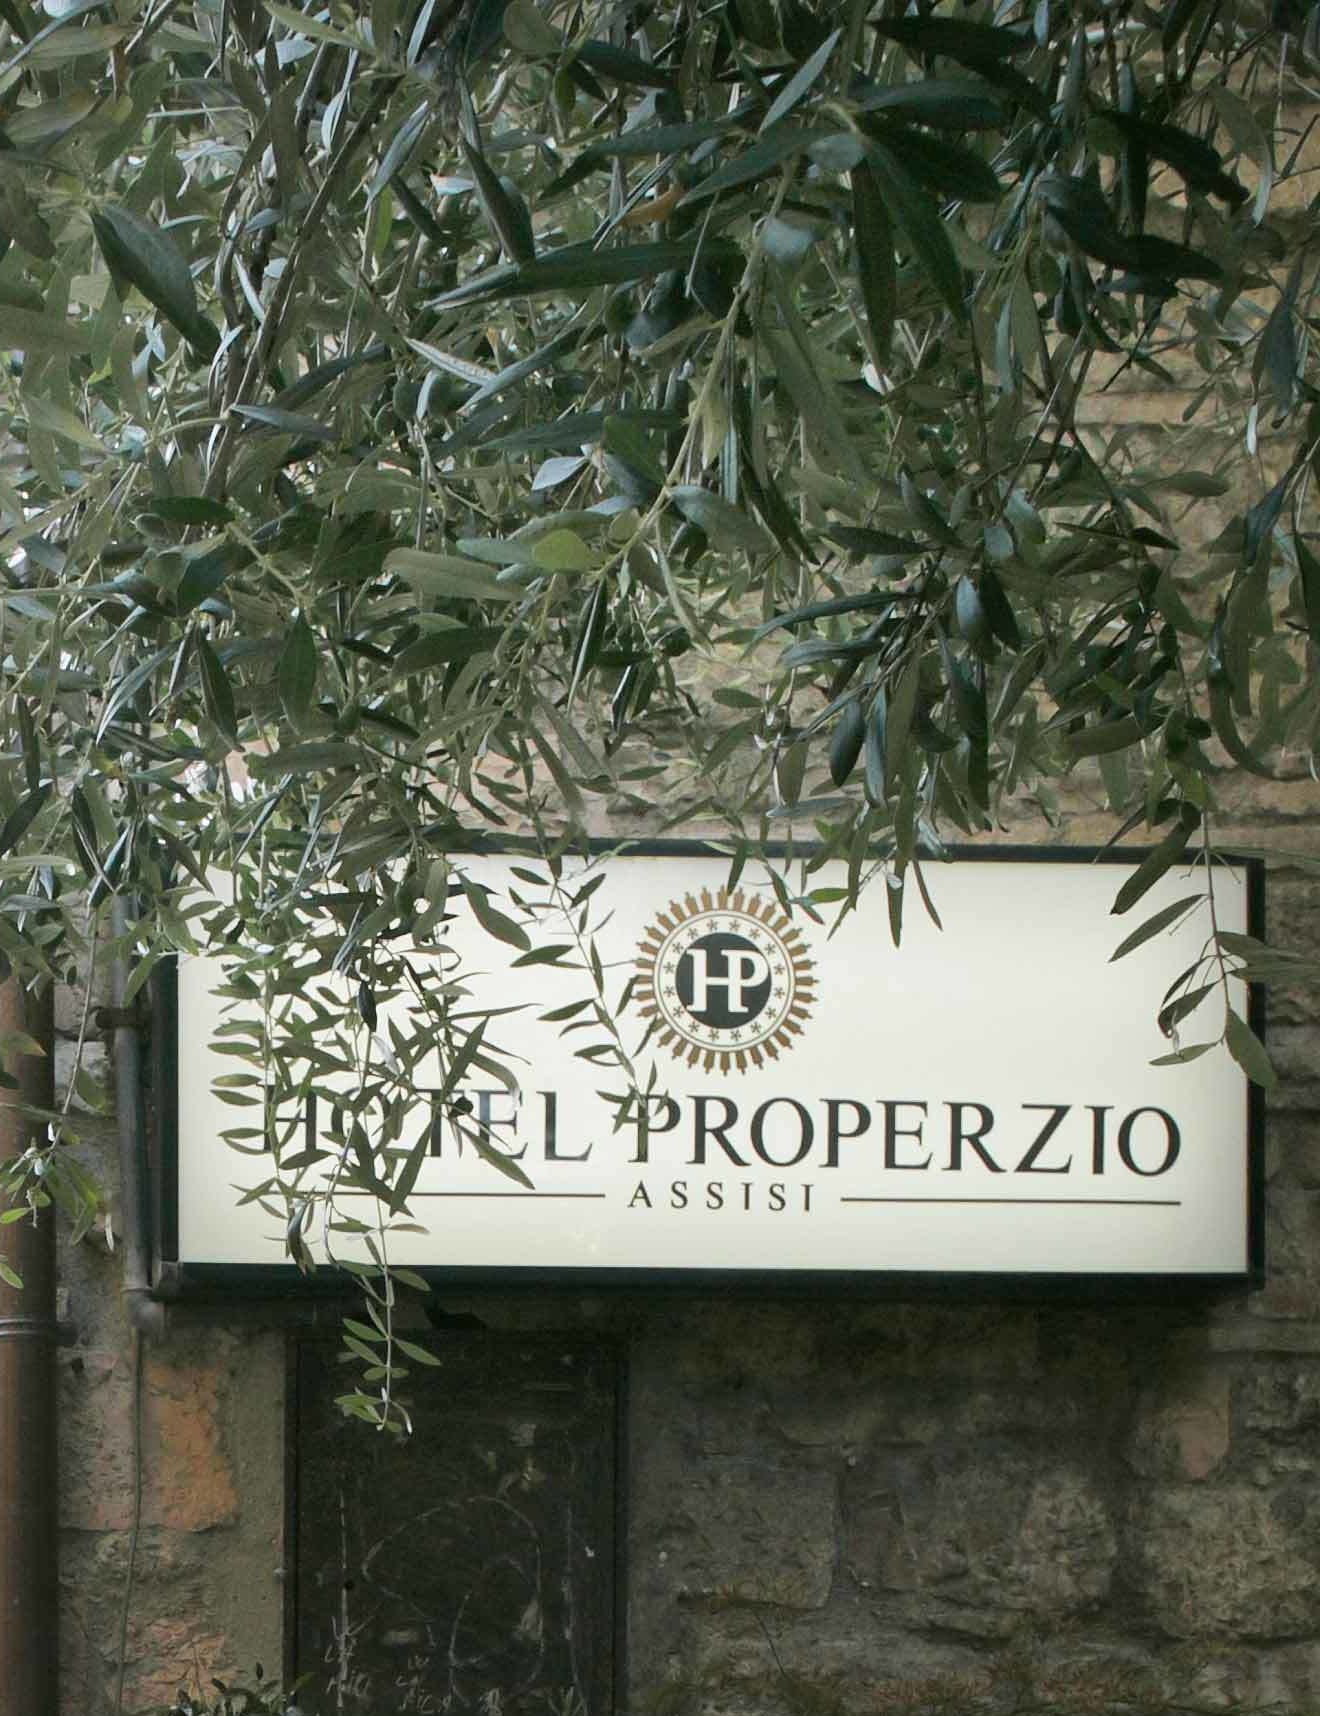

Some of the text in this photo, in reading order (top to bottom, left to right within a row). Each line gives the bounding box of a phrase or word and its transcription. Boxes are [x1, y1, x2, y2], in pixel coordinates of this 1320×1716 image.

[687, 948, 769, 1013] HP
[627, 1094, 1181, 1177] PROPERZIO
[627, 1180, 815, 1212] ASSISI
